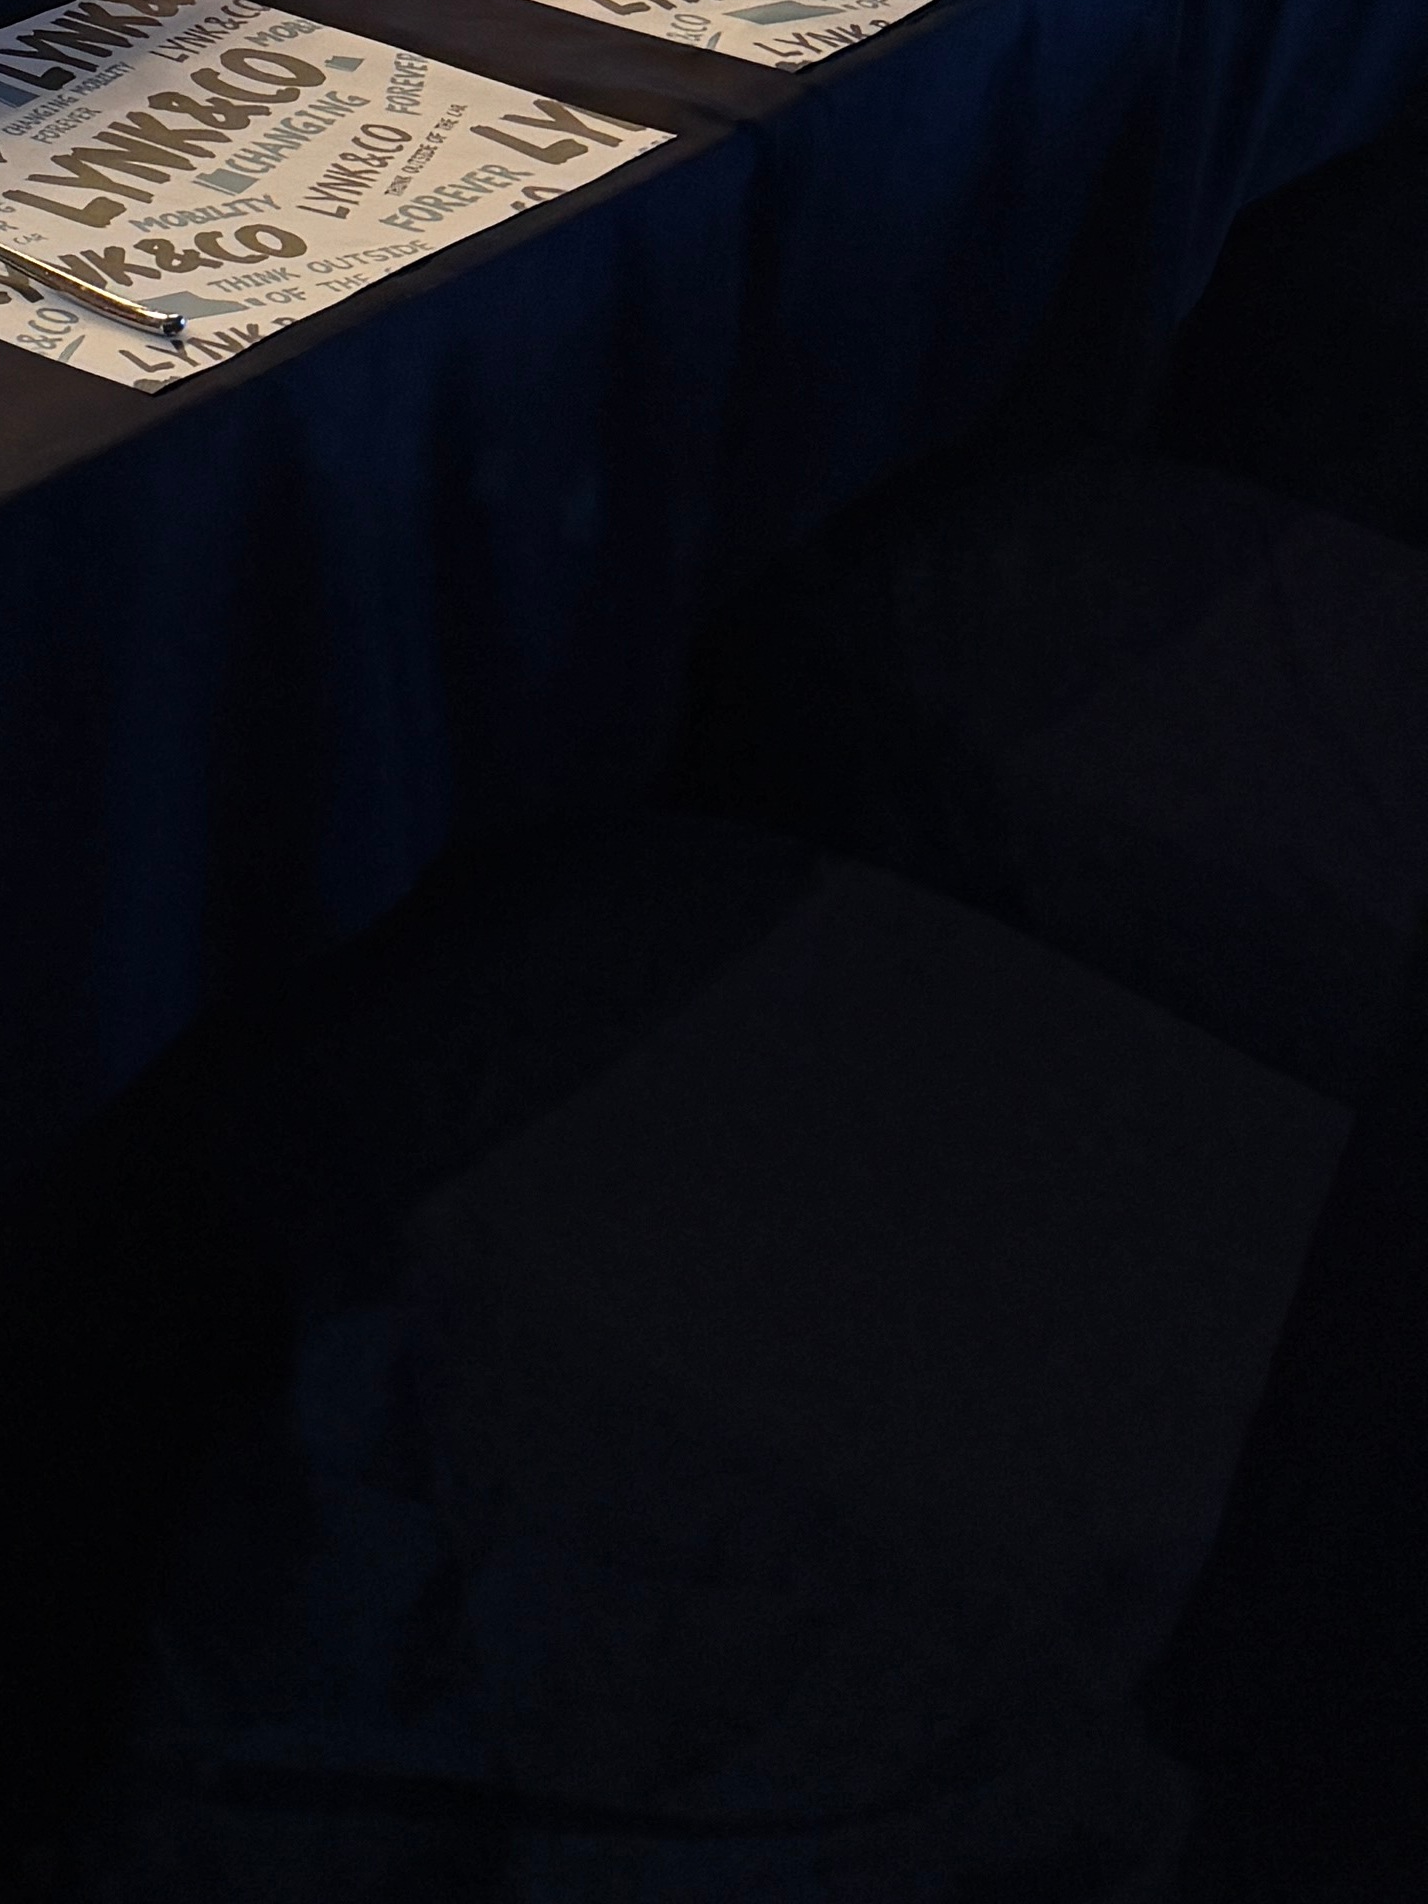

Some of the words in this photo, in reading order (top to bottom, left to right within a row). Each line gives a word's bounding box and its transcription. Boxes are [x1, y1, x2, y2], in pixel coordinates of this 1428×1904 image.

[1, 47, 327, 229] LYNK&CO
[225, 90, 372, 175] CHANGING
[296, 123, 413, 220] LYNK&CO
[379, 163, 536, 233] FOREVER
[128, 194, 283, 234] MOBILITY
[207, 265, 302, 294] THINK
[306, 238, 437, 275] OUTSIDE
[265, 286, 310, 306] OF
